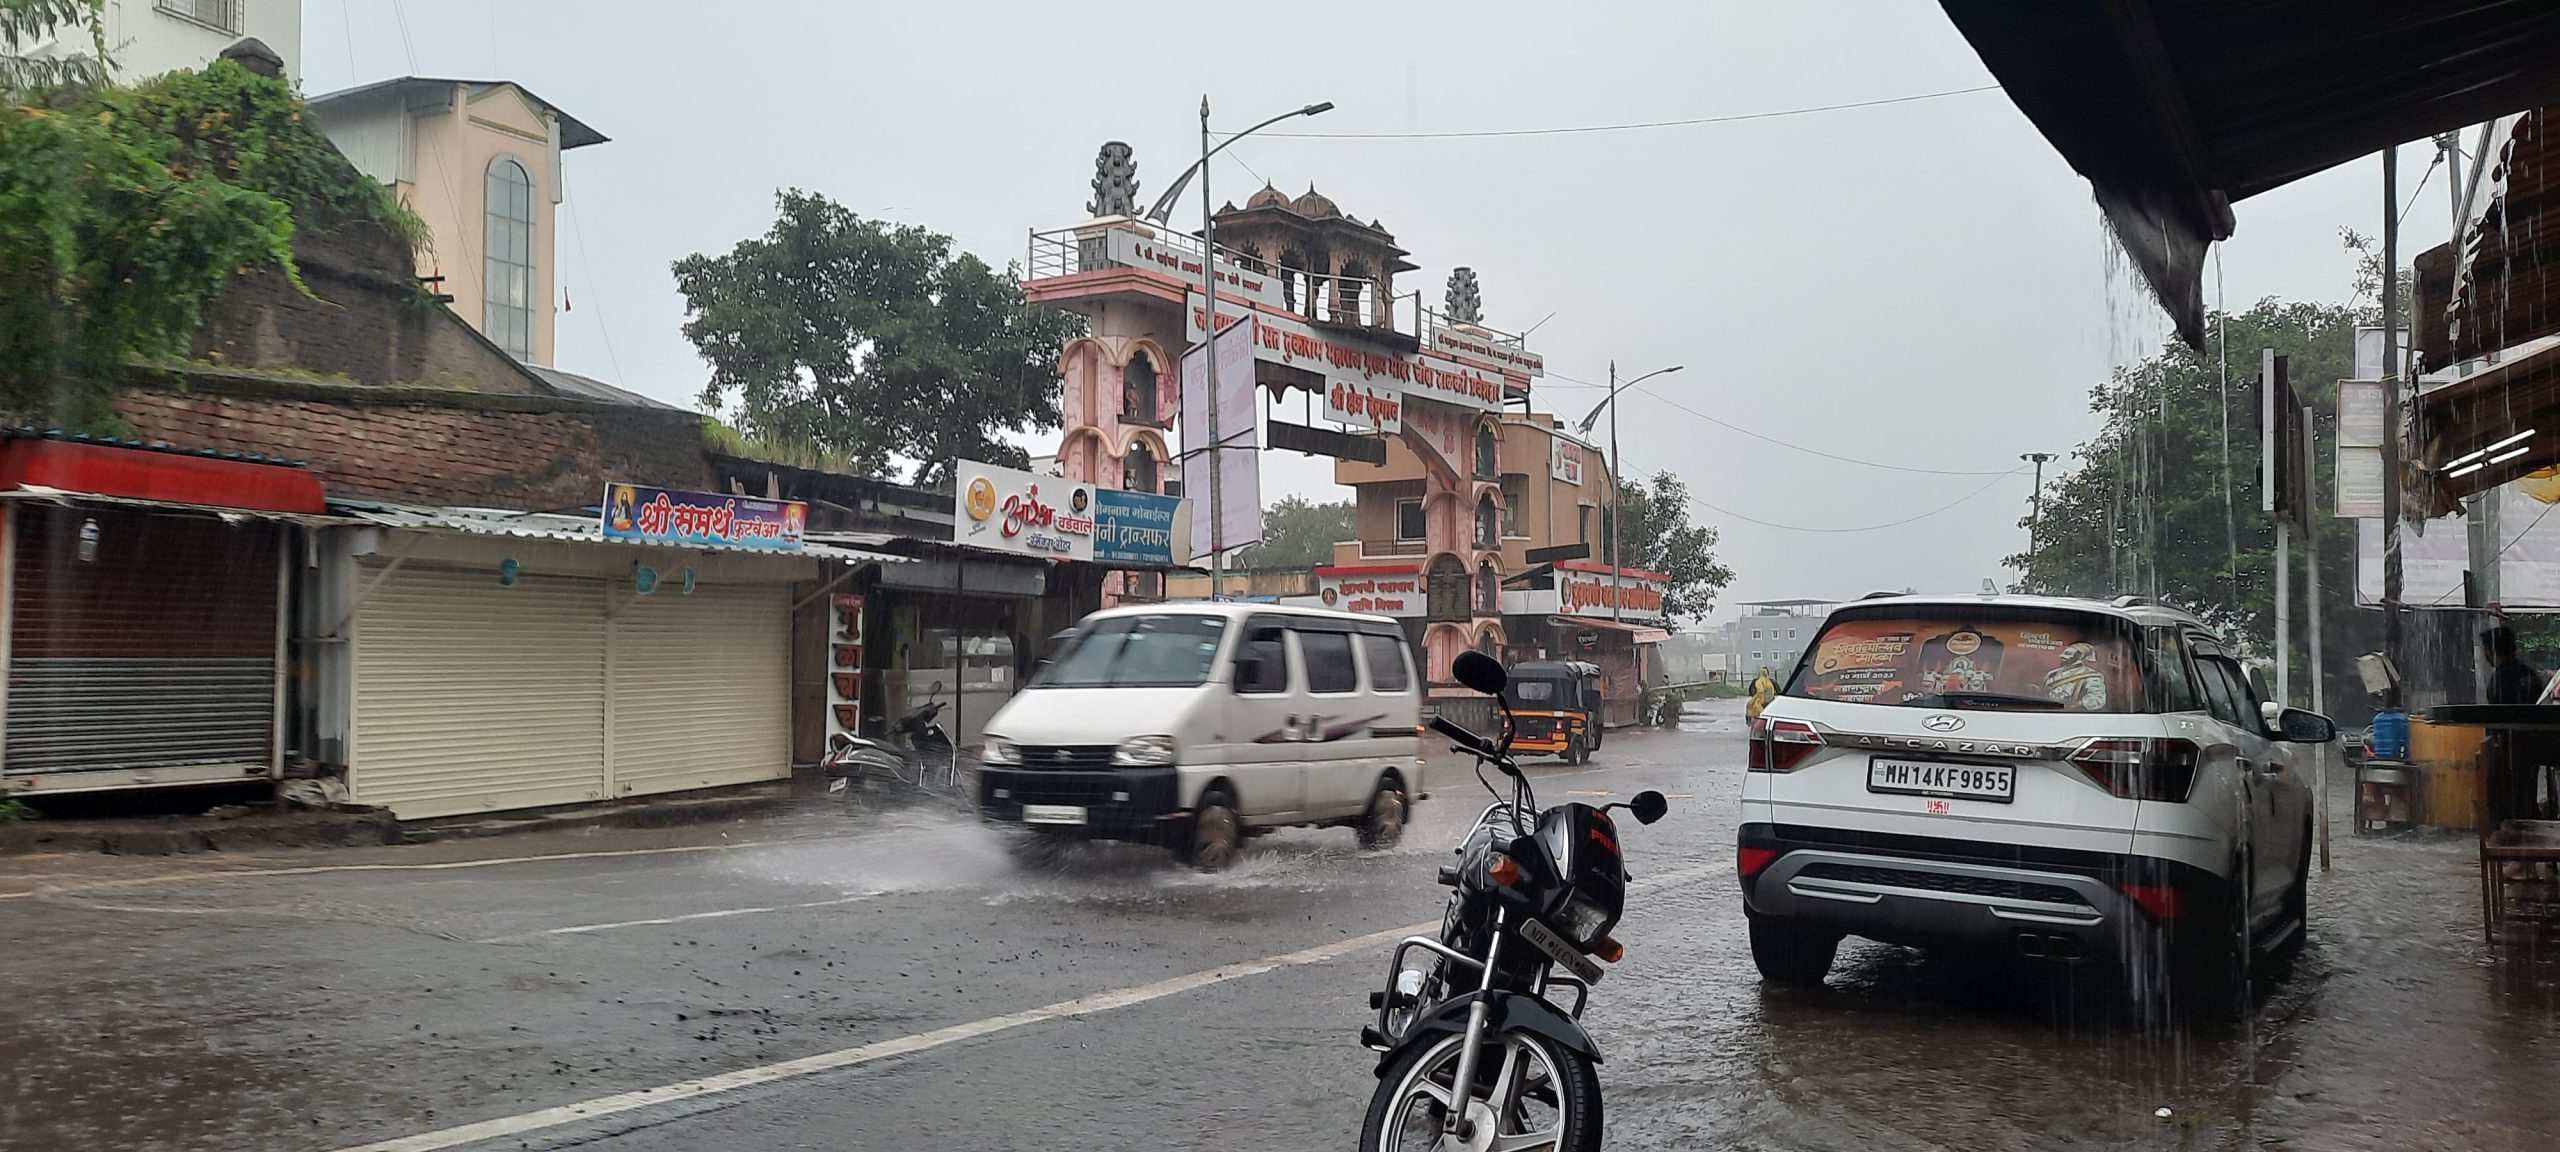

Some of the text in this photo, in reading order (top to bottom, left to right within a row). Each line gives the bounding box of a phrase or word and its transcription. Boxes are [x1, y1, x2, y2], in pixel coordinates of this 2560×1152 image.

[1283, 331, 1322, 362] तुकाराम
[1326, 341, 1361, 370] महाराज
[1364, 351, 1387, 380] मुख्य
[1331, 382, 1345, 411] श्री
[1346, 383, 1364, 415] क्षेत्र
[637, 492, 781, 542] श्री समर्थ फुटवेअर
[1058, 512, 1092, 533] वडेवाले
[1120, 526, 1170, 549] ट्रान्सफर
[1858, 736, 2030, 755] ALCAZAR
[1885, 764, 2009, 791] MH14KF9855
